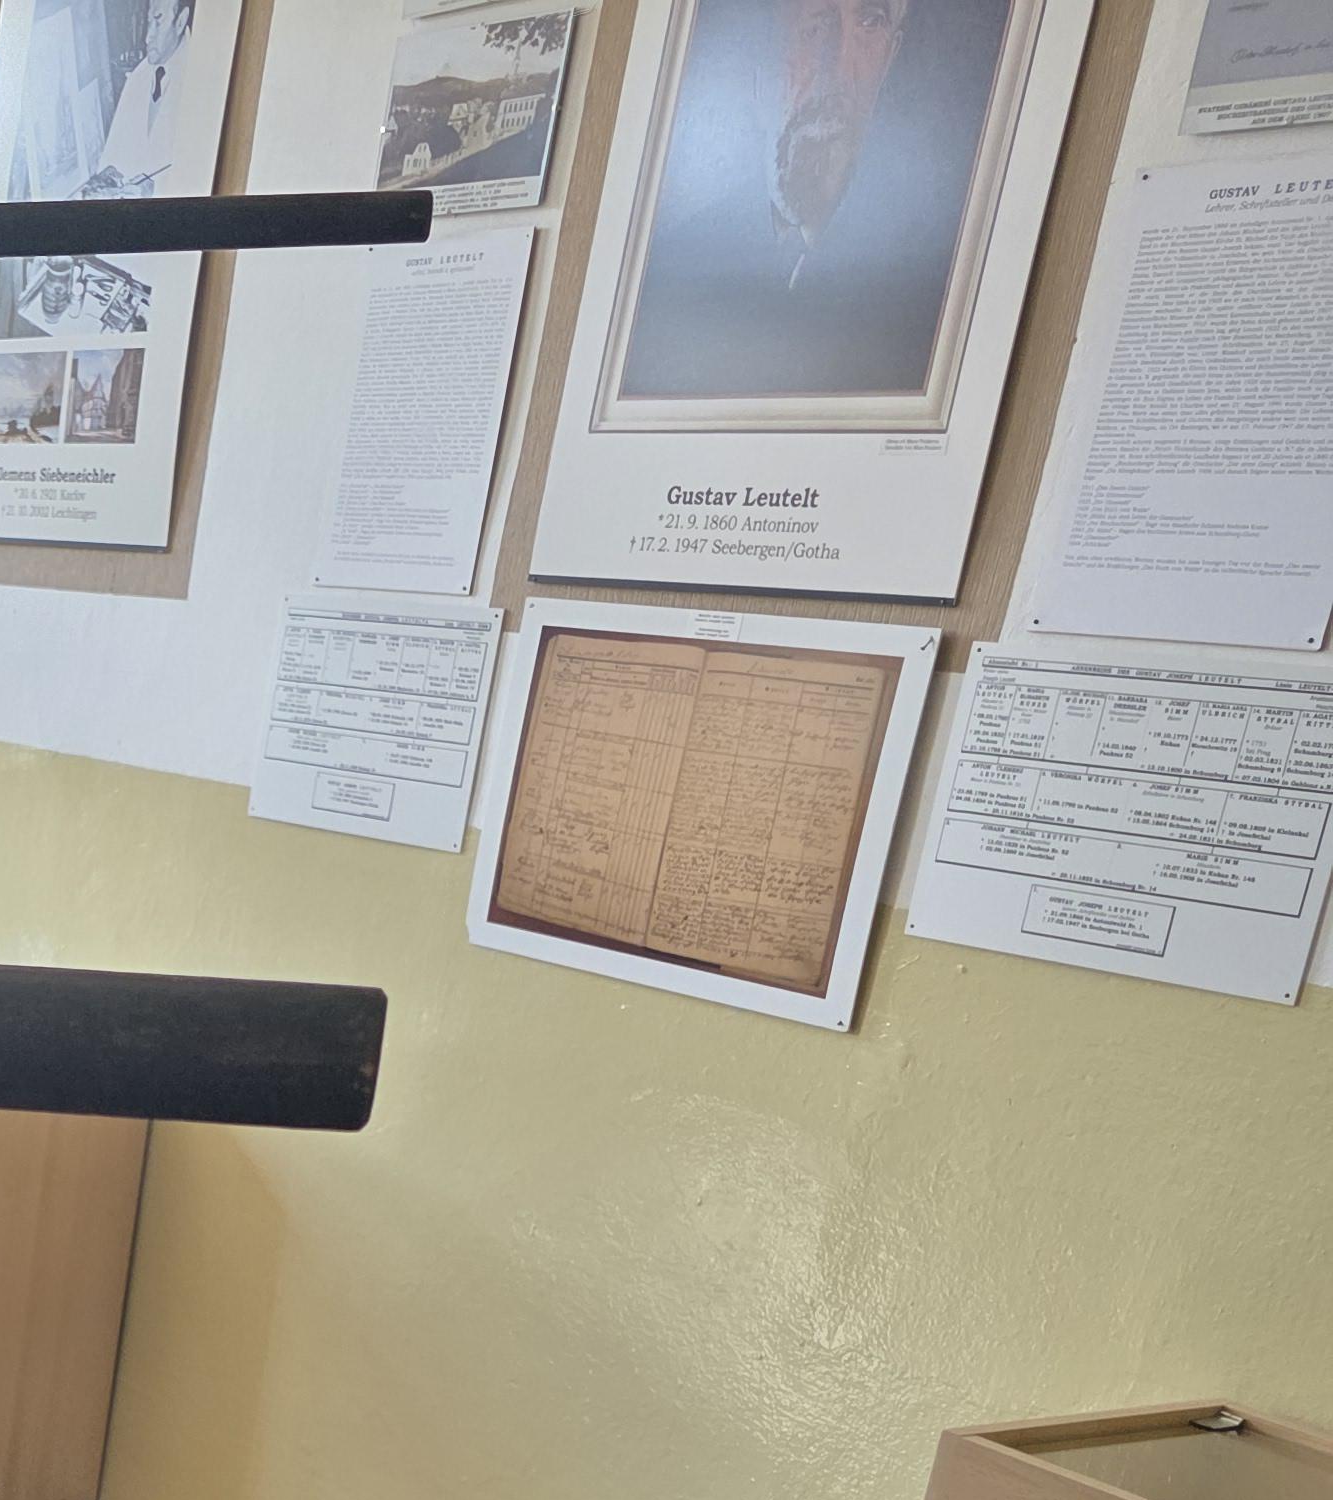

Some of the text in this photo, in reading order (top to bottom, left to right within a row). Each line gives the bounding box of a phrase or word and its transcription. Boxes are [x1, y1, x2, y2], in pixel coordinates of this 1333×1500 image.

[1209, 185, 1260, 200] GUSTAV
[667, 486, 820, 508] Gustav Leutelt
[703, 514, 738, 531] 1860
[675, 537, 708, 553] 1947
[711, 539, 840, 562] Seebergen/Gotha
